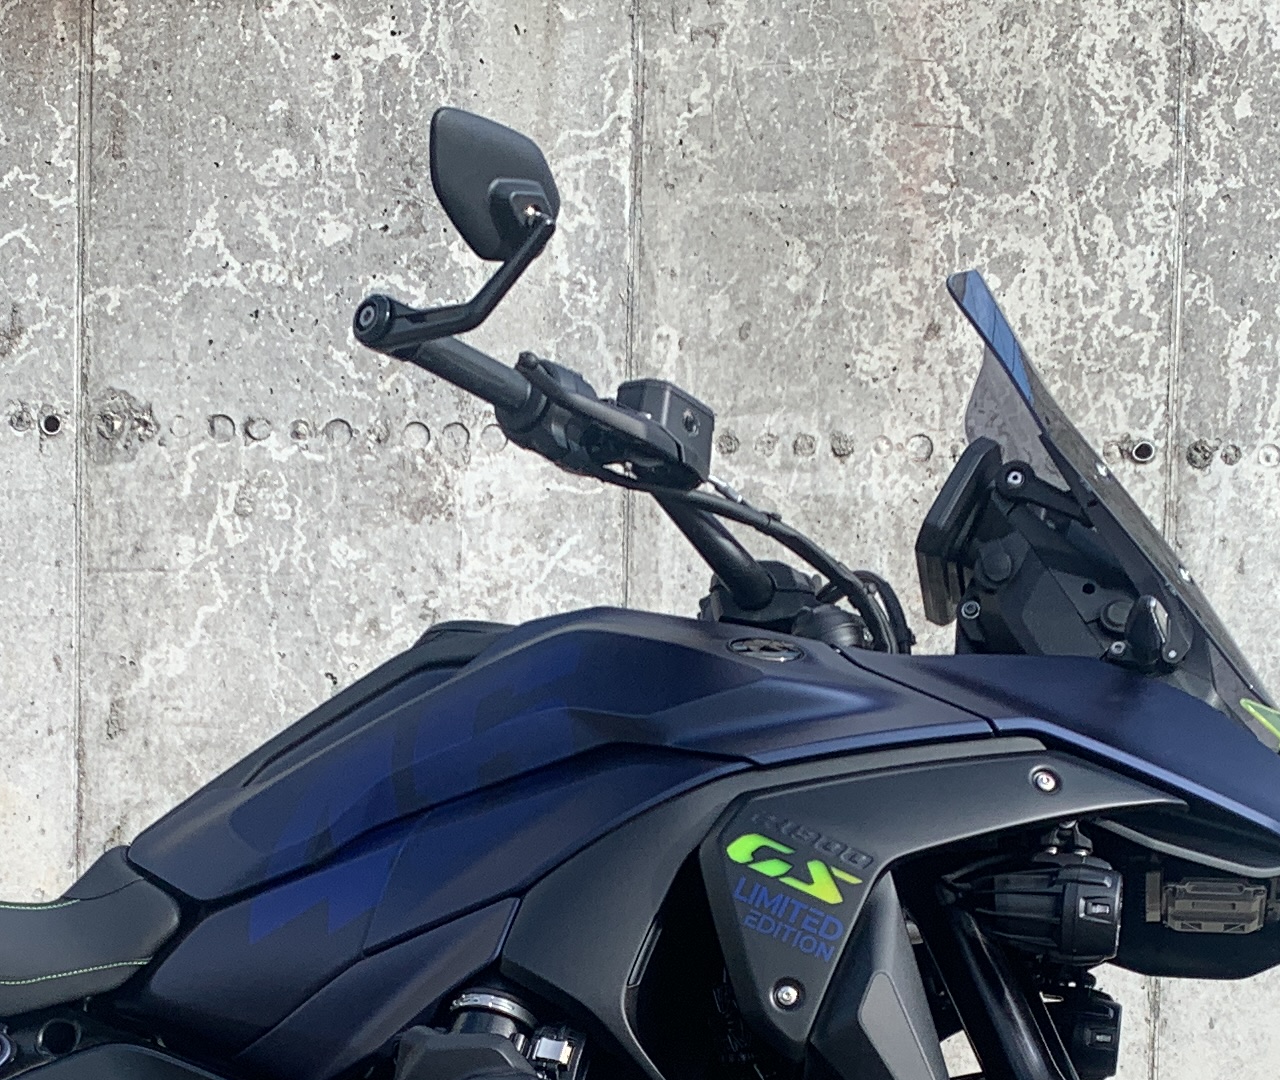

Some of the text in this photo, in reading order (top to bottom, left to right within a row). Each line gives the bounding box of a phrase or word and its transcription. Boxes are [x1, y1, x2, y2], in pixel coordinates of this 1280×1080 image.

[726, 833, 863, 904] GS
[732, 876, 845, 942] LIMITED
[743, 910, 838, 963] EDITION
